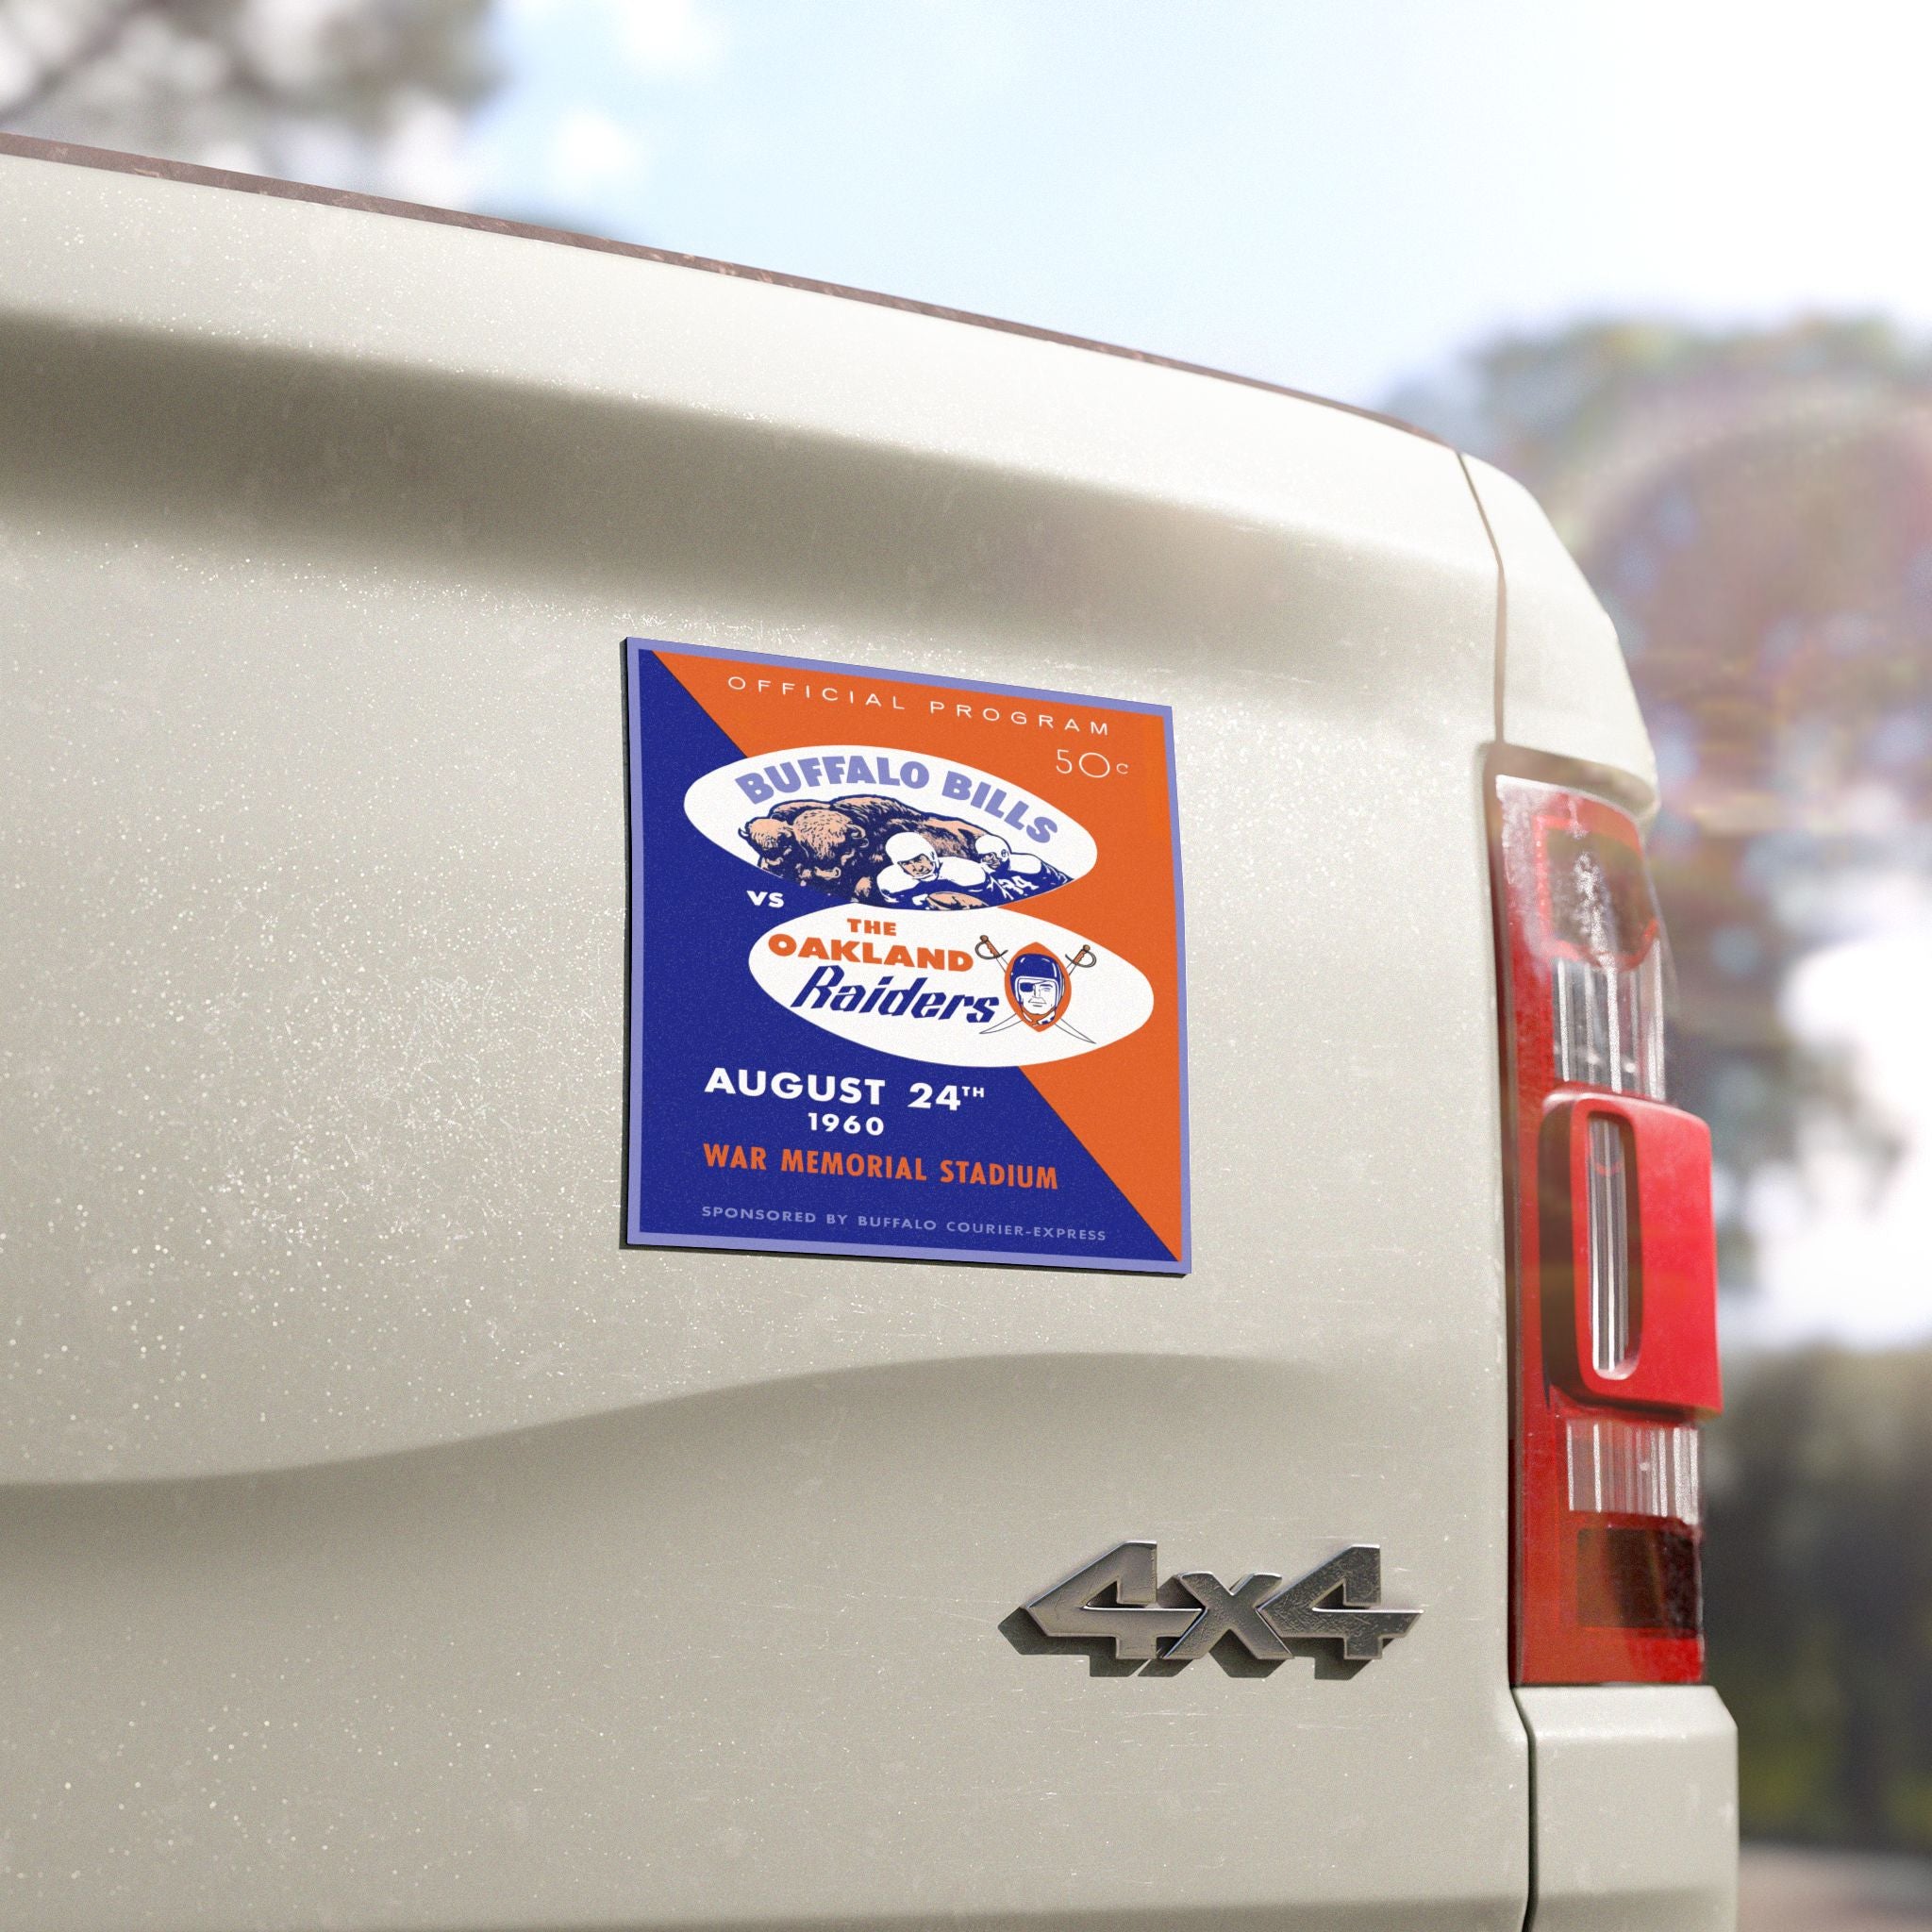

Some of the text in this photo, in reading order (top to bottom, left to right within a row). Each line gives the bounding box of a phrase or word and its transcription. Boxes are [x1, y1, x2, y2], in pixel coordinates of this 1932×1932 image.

[727, 675, 1110, 736] OFFICIAL PROGRAM
[735, 755, 1058, 844] BUFFALO BILLS
[747, 891, 785, 910] VS
[846, 917, 897, 937] THE
[768, 933, 974, 973] OAKLAND
[791, 965, 999, 1024] Raiders
[704, 1067, 985, 1111] AUGUST 24TH
[808, 1112, 885, 1137] 1960
[703, 1143, 1058, 1191] WAR MEMORIAL STADIUM
[701, 1206, 1107, 1241] SPONSORED BY BUFFALO COURIER-EXPRESS
